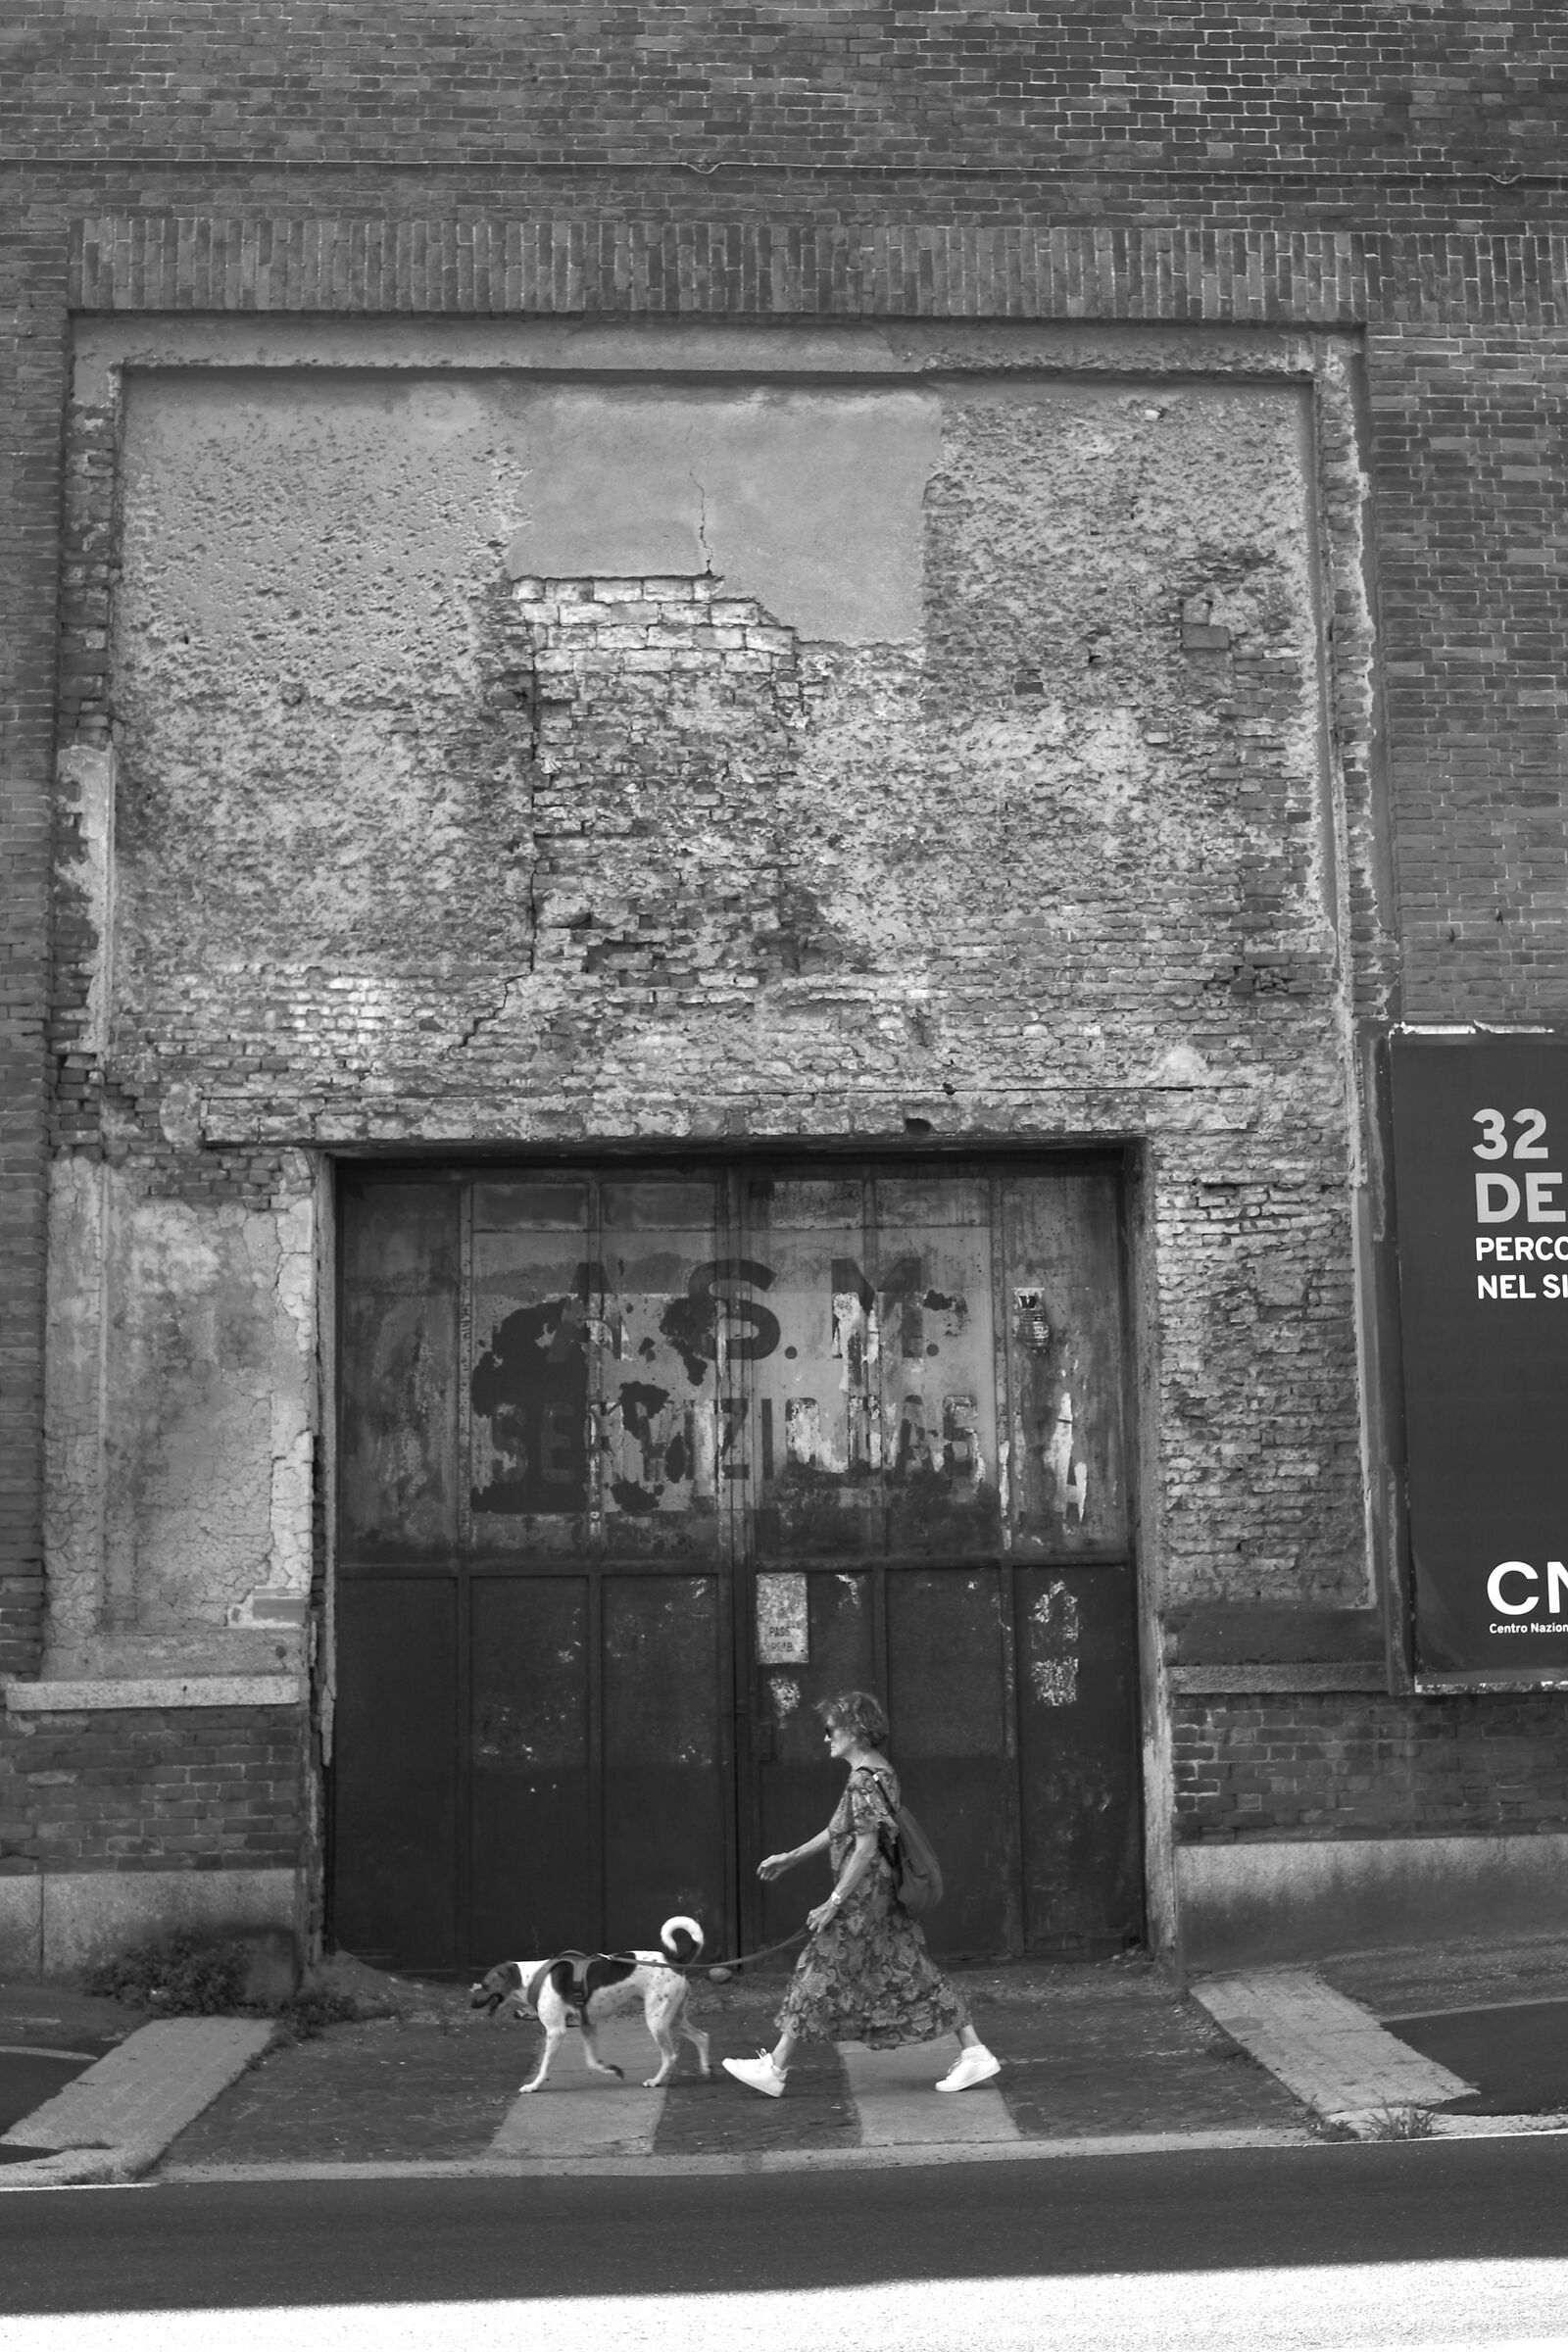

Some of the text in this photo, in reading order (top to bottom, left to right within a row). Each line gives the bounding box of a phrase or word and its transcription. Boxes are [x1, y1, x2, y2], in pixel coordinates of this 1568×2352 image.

[1472, 1108, 1548, 1160] 32
[1474, 1172, 1567, 1224] DE
[1477, 1274, 1537, 1299] NEL
[1489, 1623, 1528, 1634] Centro
